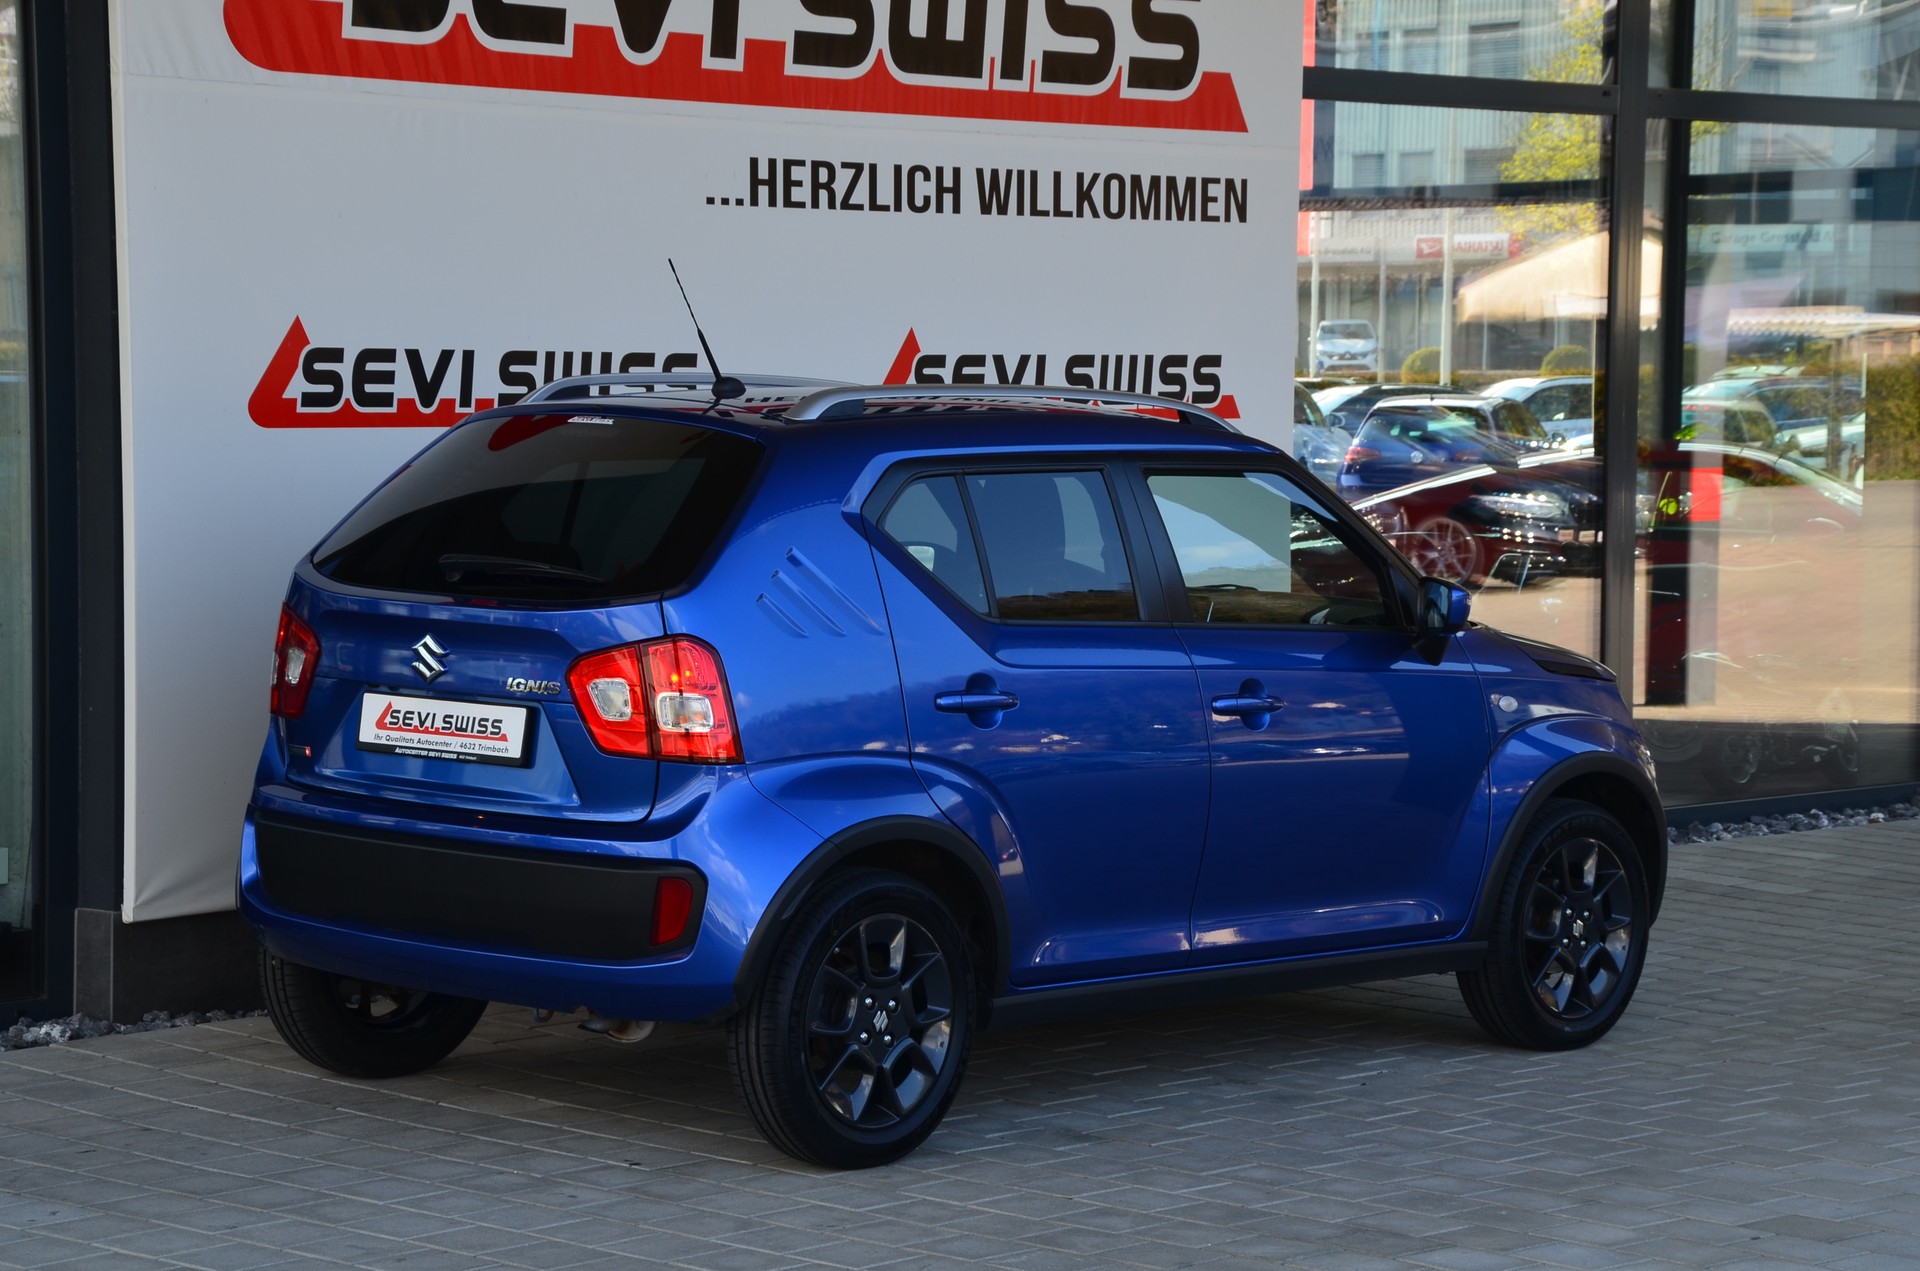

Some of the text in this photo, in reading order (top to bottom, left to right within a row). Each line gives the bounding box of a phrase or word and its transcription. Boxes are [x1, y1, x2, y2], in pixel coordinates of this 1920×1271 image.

[975, 167, 1249, 223] WILLKOMMEN
[301, 347, 475, 408] SEVI
[505, 677, 561, 696] IGNIS
[388, 709, 503, 736] SEVI SWISS
[374, 733, 383, 742] Ihr
[416, 736, 453, 749] Autocenter
[459, 741, 476, 751] 4632
[478, 743, 509, 755] Trimbach
